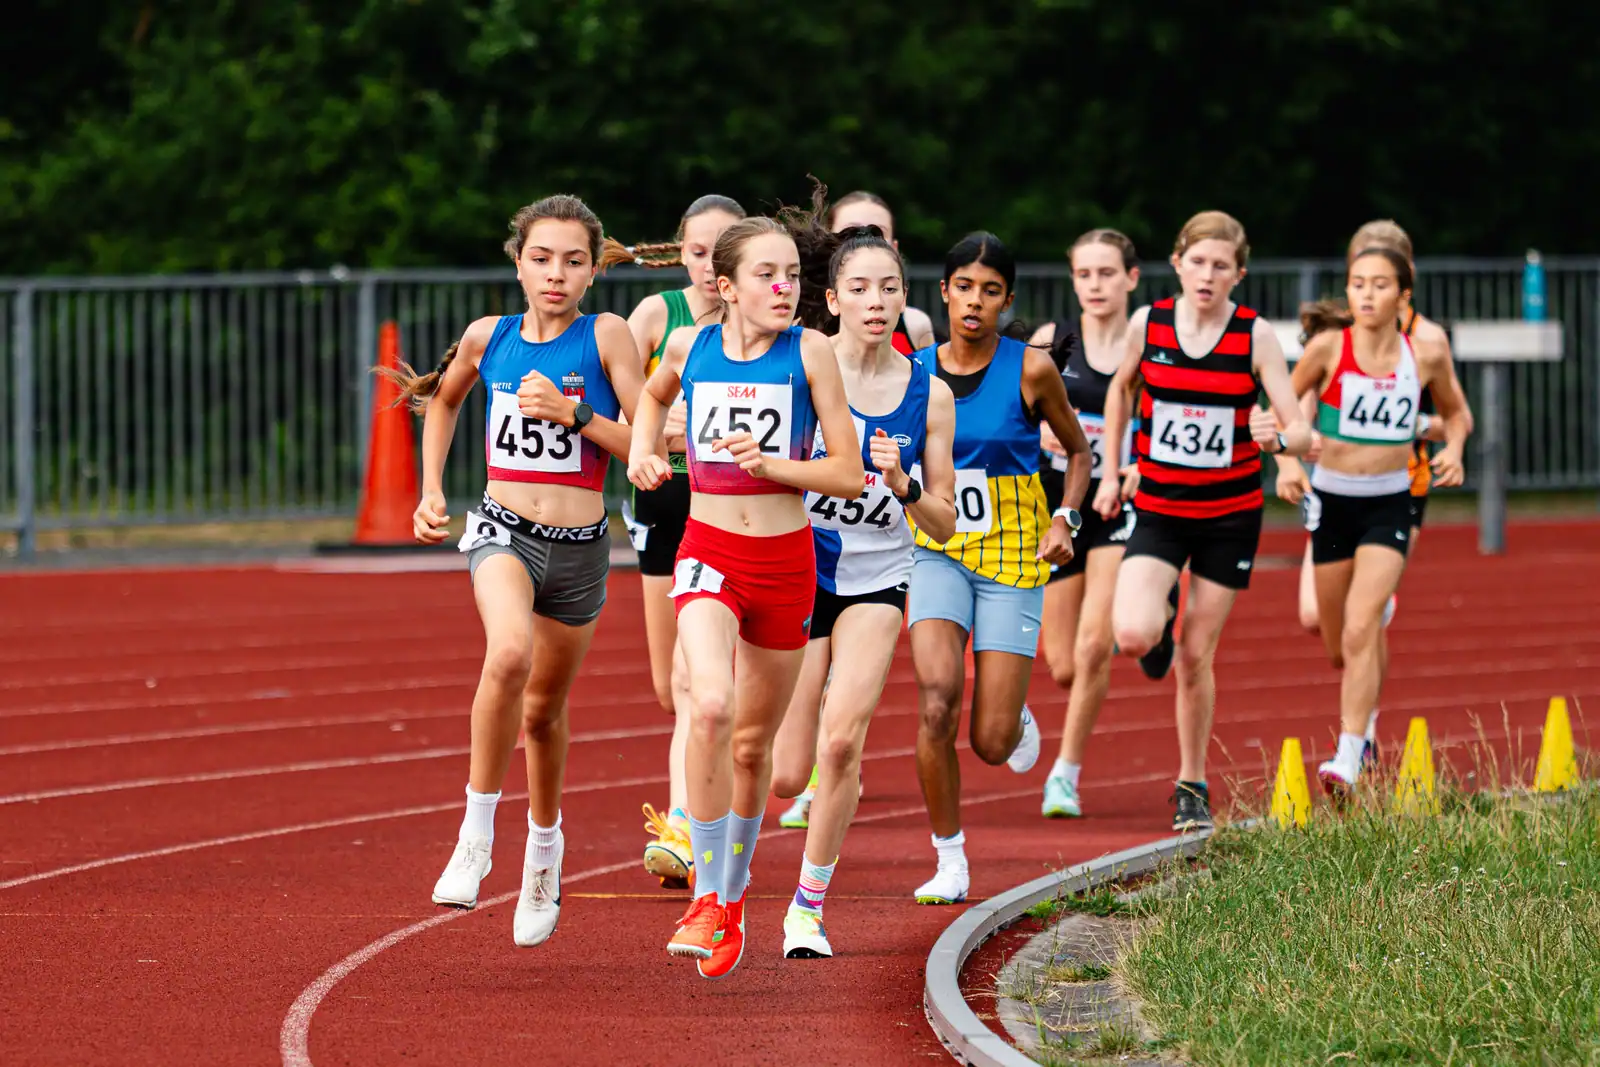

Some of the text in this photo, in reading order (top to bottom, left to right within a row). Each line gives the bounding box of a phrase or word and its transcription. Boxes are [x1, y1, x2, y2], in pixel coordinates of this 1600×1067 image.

[697, 406, 781, 453] 452
[1348, 394, 1412, 429] 442
[495, 414, 573, 460] 453
[1159, 419, 1227, 457] 434
[810, 491, 892, 529] 454
[954, 486, 985, 522] 0
[530, 523, 597, 541] NIKE
[688, 561, 704, 589] 1
